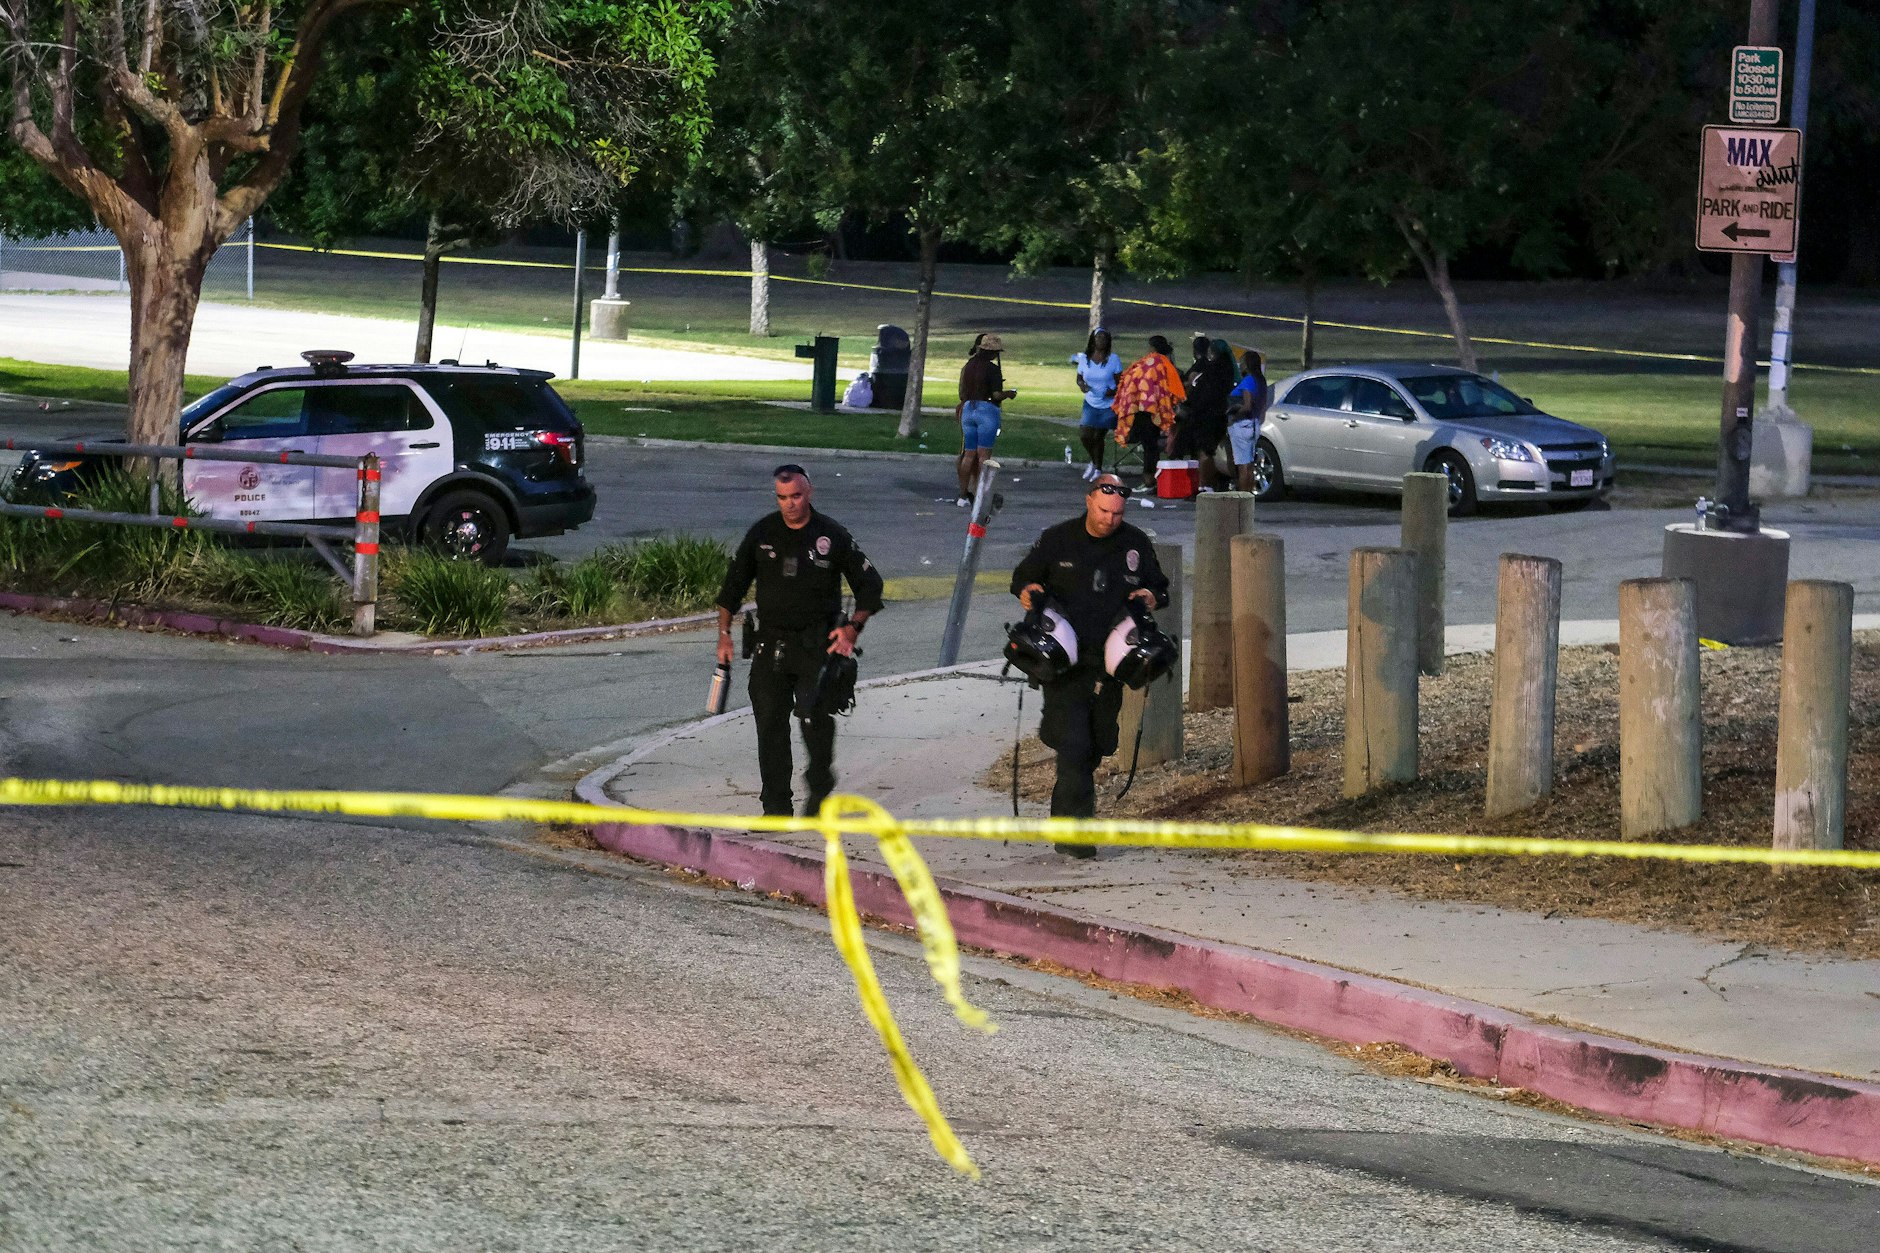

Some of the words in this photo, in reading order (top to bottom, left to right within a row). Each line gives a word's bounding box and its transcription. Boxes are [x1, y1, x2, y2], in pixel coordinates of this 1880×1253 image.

[1738, 53, 1761, 63] Park
[1737, 63, 1775, 74] Closed
[1764, 77, 1776, 85] PM
[1735, 101, 1746, 110] No
[1727, 137, 1773, 167] MAX
[1702, 198, 1741, 217] PARK
[1742, 204, 1759, 214] AND
[1760, 201, 1793, 220] RIDE
[234, 494, 266, 502] POLICE
